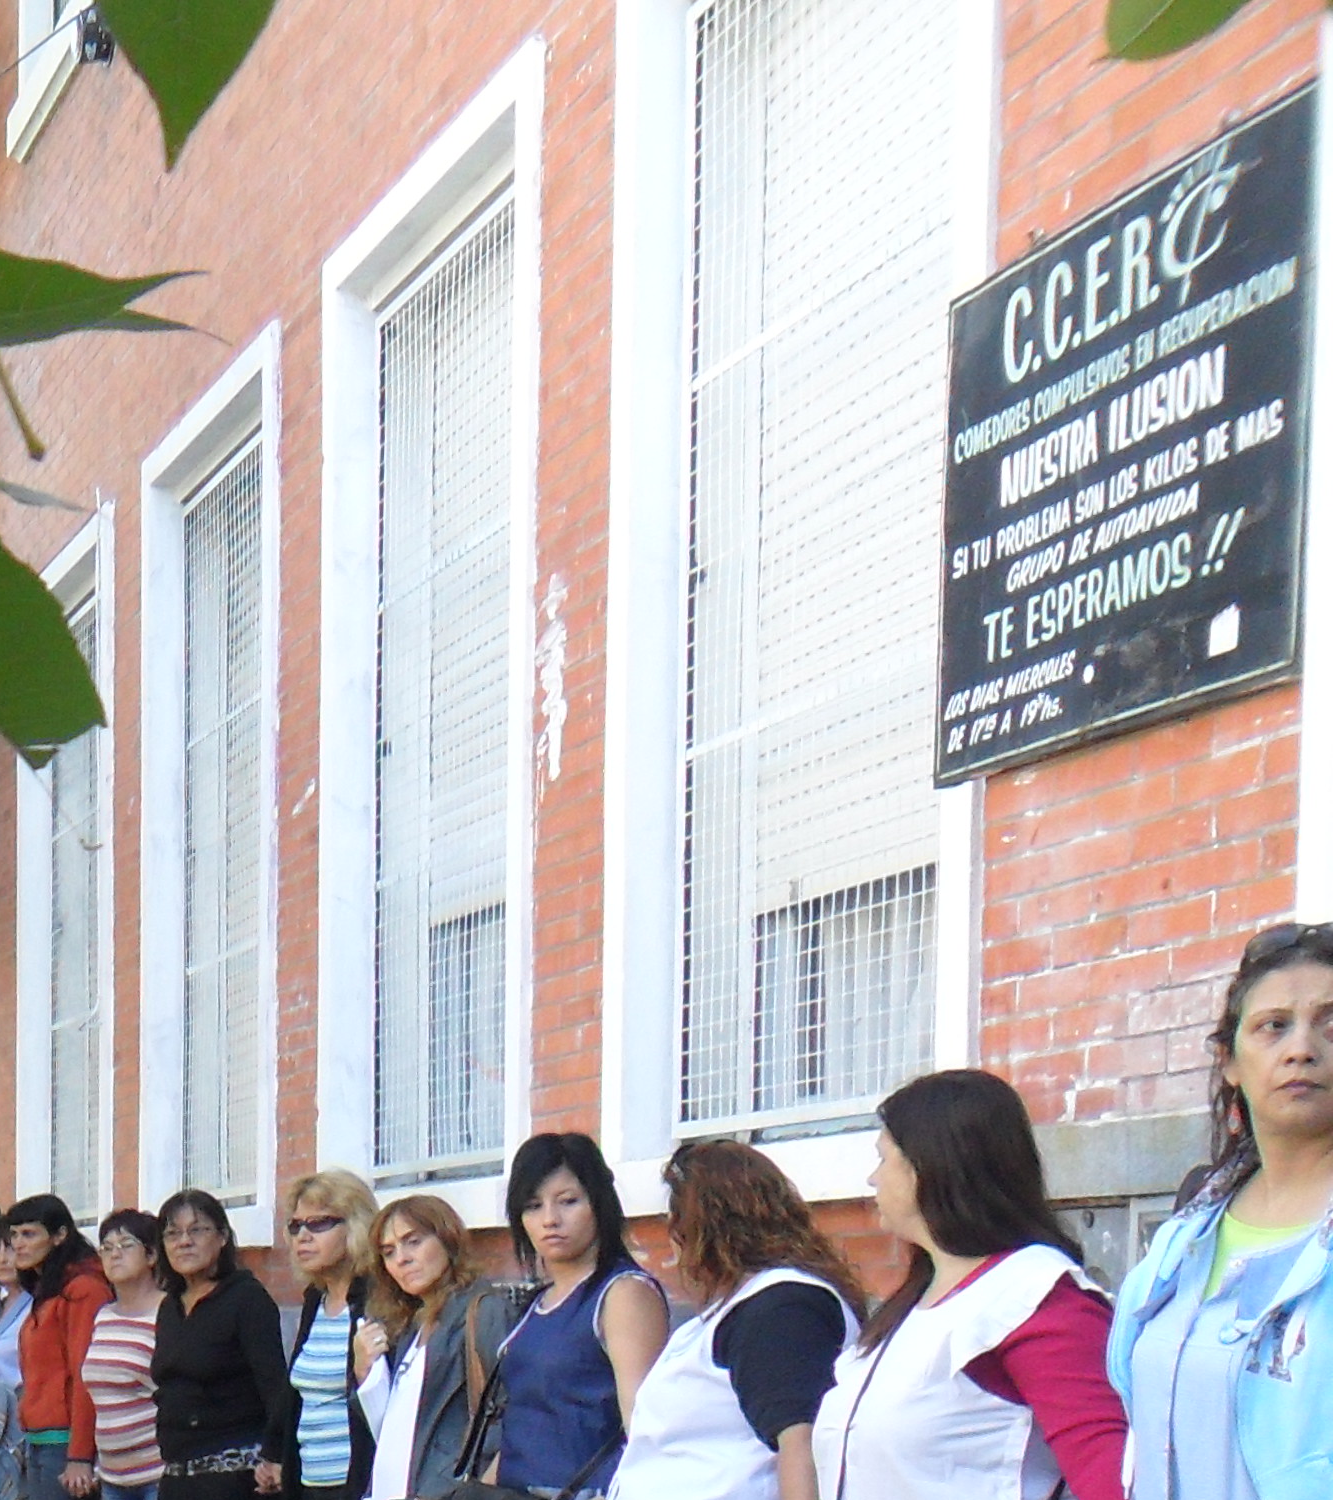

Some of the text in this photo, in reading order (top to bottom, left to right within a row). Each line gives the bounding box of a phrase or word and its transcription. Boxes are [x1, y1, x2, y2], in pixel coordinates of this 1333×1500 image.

[954, 255, 1299, 461] COMEDORES COMPULSIVOS EN RECUPERACION
[951, 397, 1284, 580] SI TU PROBLEMA SON LOS KILOS DE MAS
[999, 343, 1228, 508] NUESTRA ILUSION
[982, 606, 1015, 664] TE
[1025, 531, 1192, 649] ESPERAMOS
[1005, 480, 1201, 593] GRUPO DE AUTOAYUDA
[943, 648, 1077, 722] LOS DIAS MIERCOLES
[946, 723, 968, 754] DE
[998, 708, 1013, 736] A
